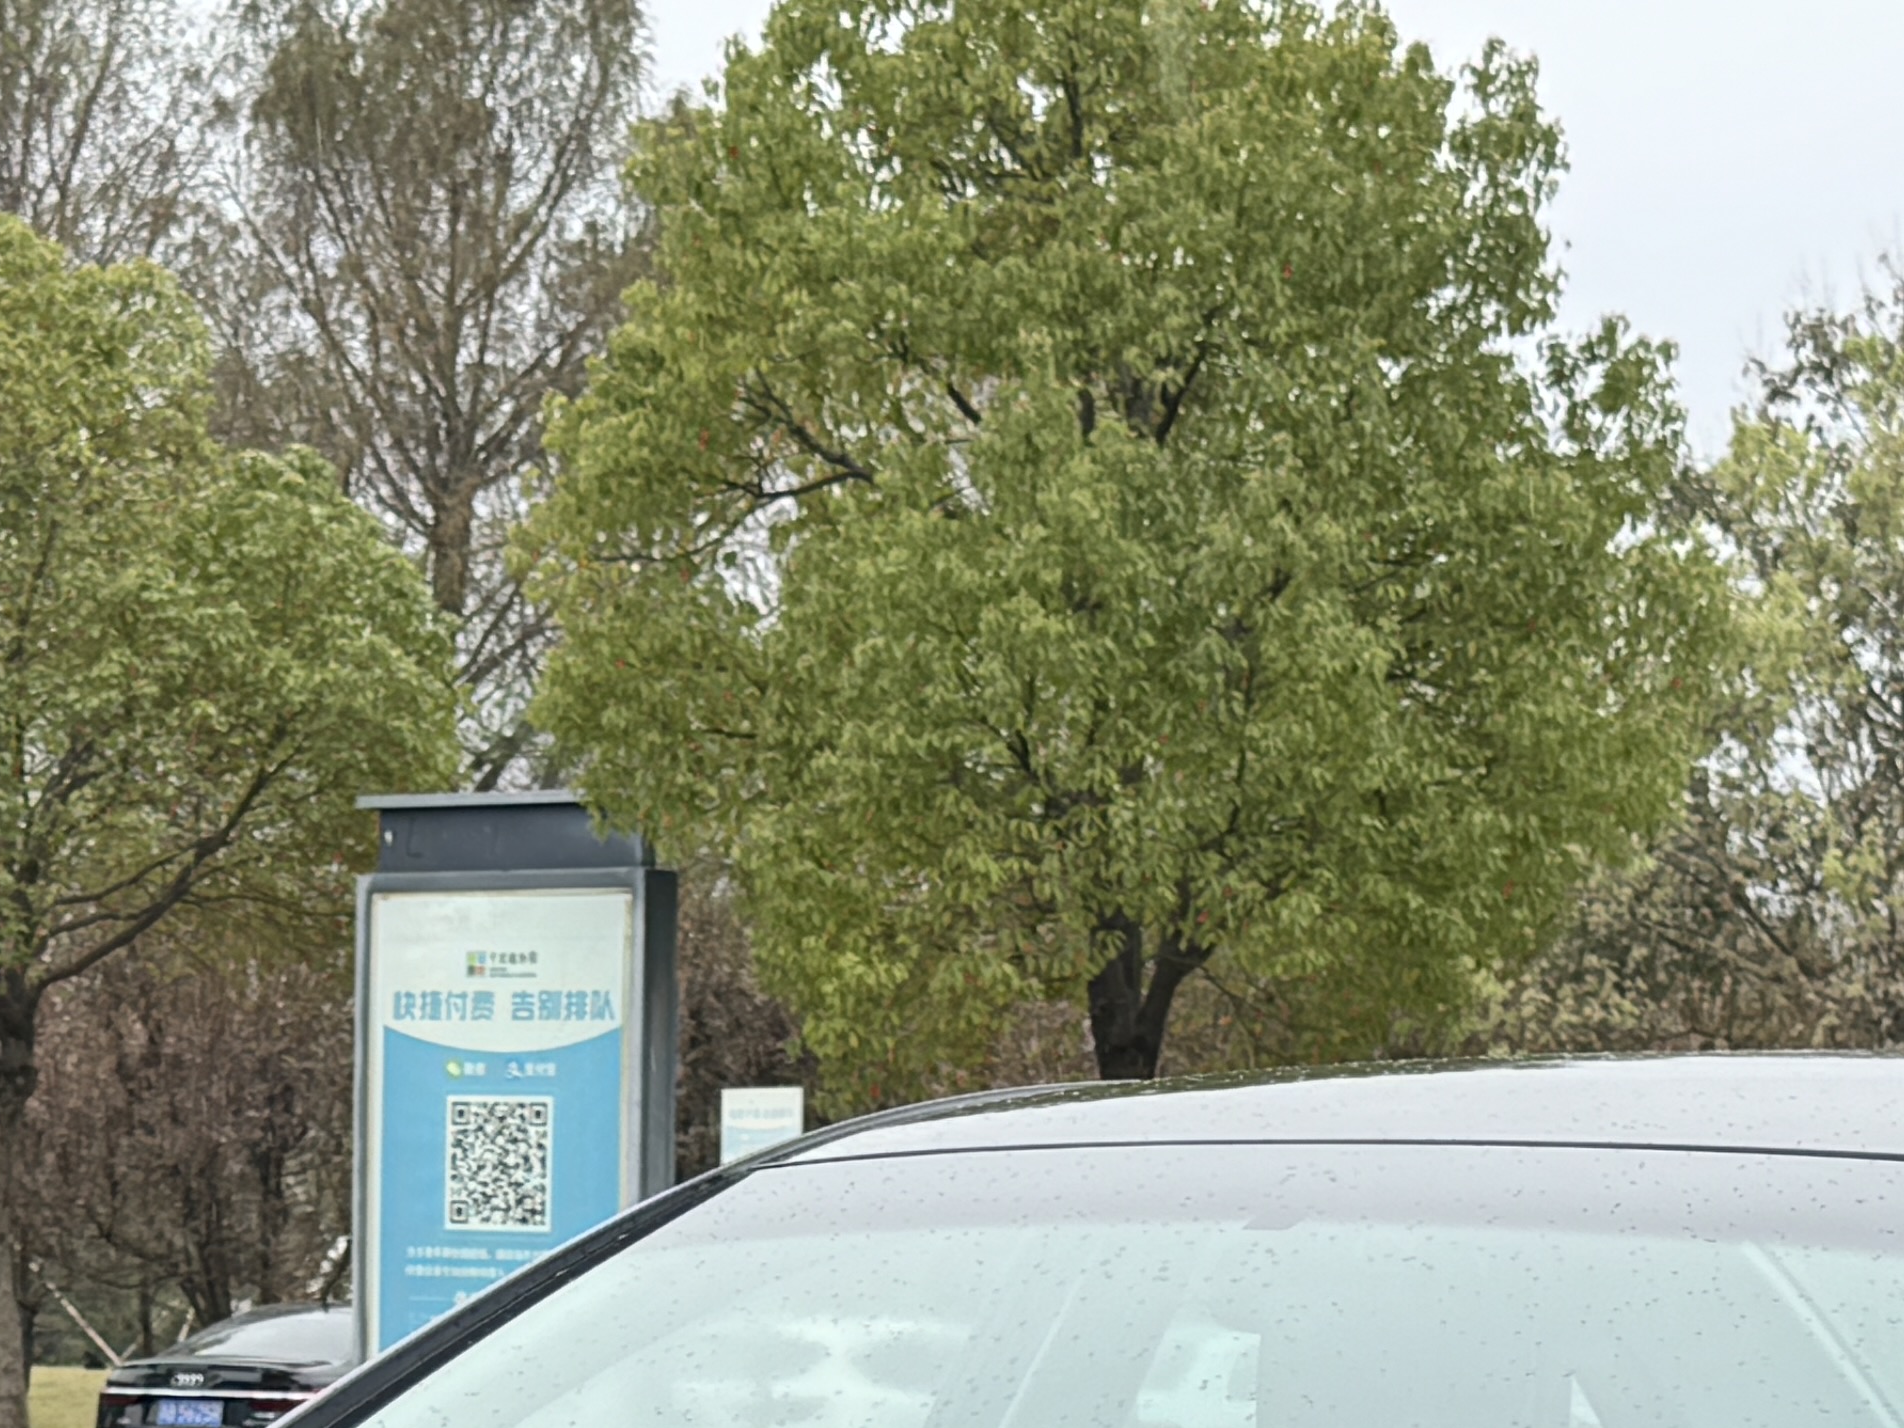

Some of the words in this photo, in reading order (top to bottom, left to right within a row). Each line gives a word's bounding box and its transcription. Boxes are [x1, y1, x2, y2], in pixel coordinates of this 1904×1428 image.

[392, 990, 496, 1021] 快捷付费
[510, 990, 615, 1021] 告别排队
